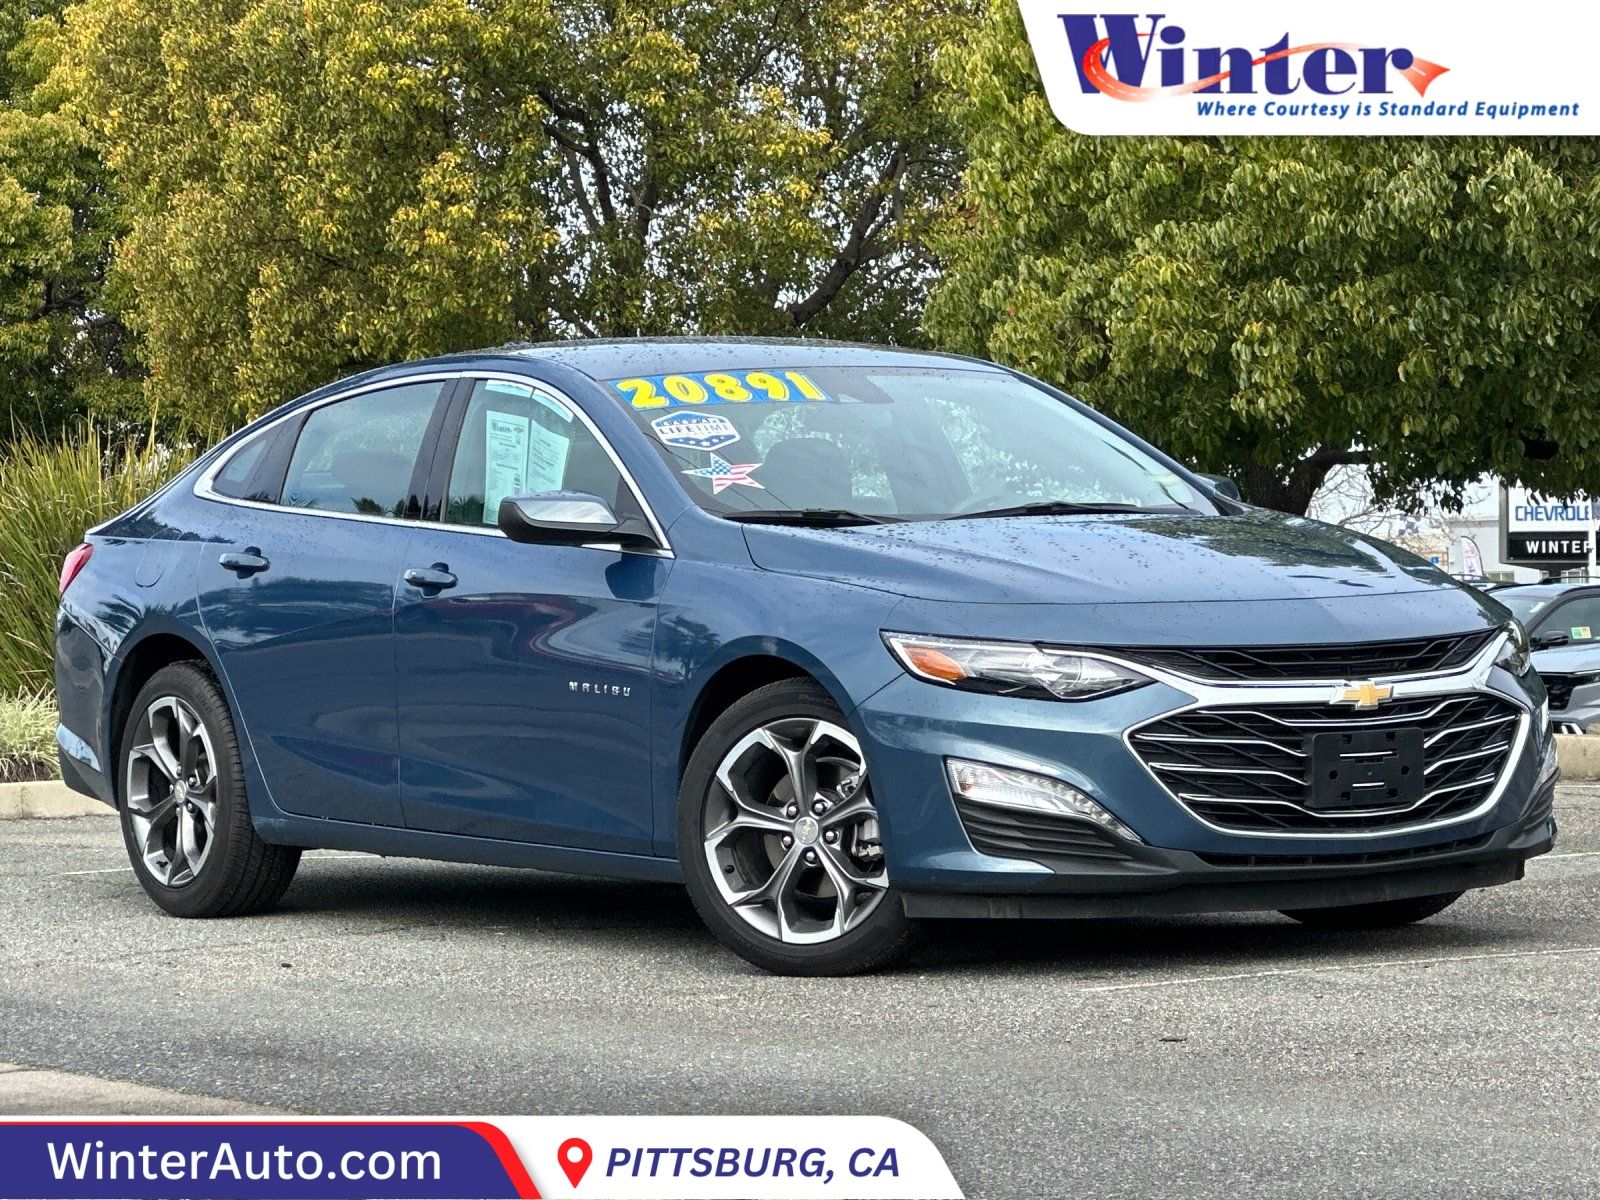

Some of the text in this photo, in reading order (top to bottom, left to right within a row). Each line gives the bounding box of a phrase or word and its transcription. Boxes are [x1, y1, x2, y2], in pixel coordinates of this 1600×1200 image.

[616, 371, 827, 409] 20891
[659, 423, 730, 435] LIFETIME
[1515, 505, 1590, 521] CHEVROLE
[569, 681, 631, 697] MALIBU
